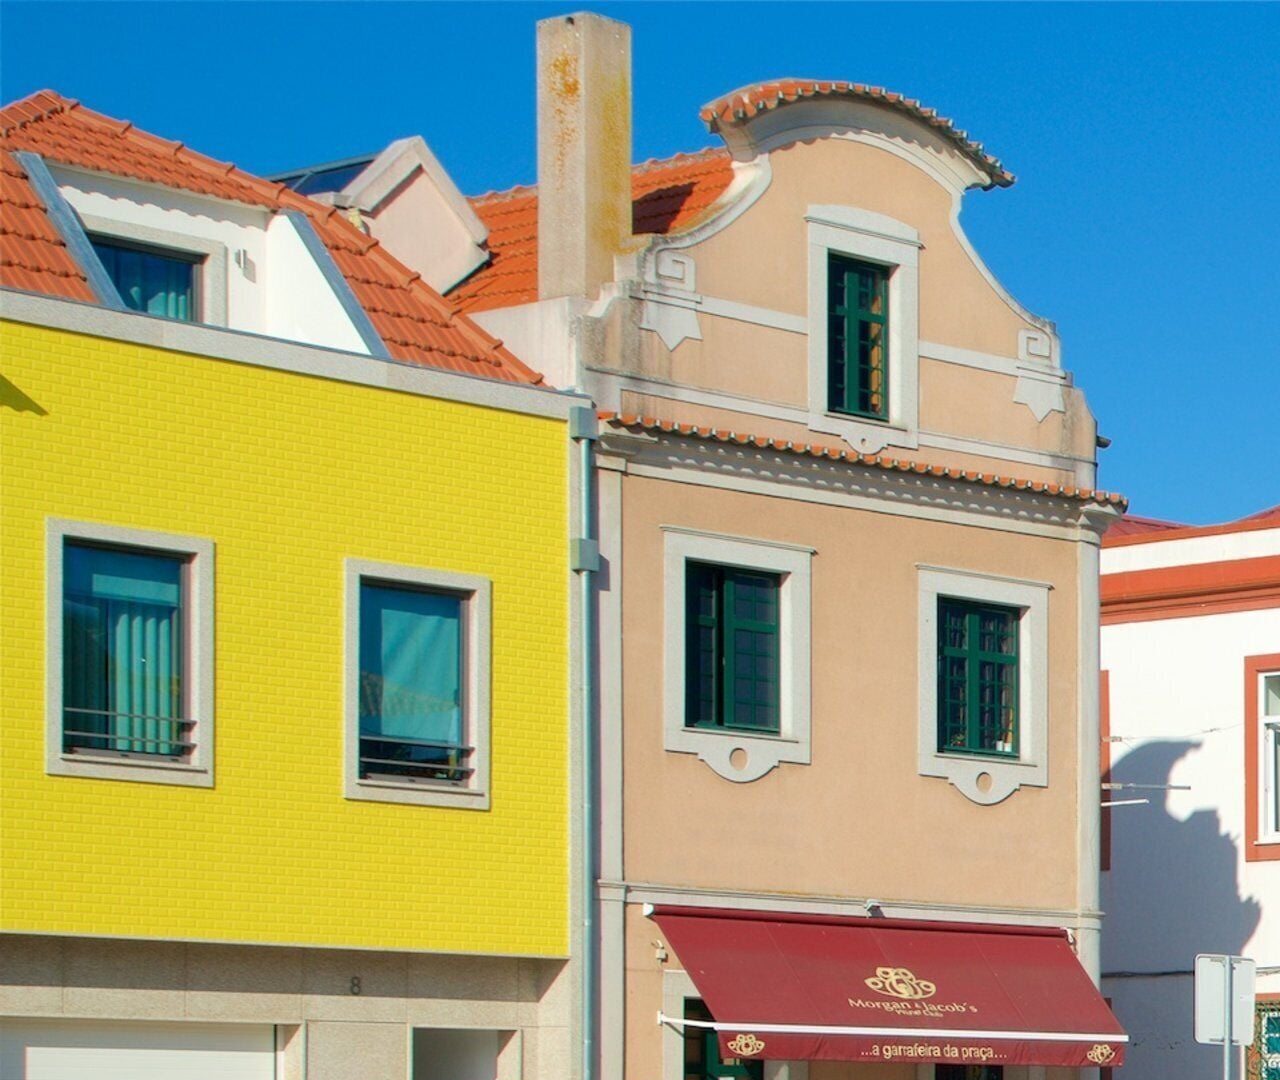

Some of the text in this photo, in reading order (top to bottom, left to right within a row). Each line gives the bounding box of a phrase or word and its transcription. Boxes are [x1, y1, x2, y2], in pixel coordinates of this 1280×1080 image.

[350, 975, 361, 995] 8
[847, 998, 911, 1012] Morgan
[882, 1043, 941, 1059] garrafeira
[943, 1044, 960, 1057] da
